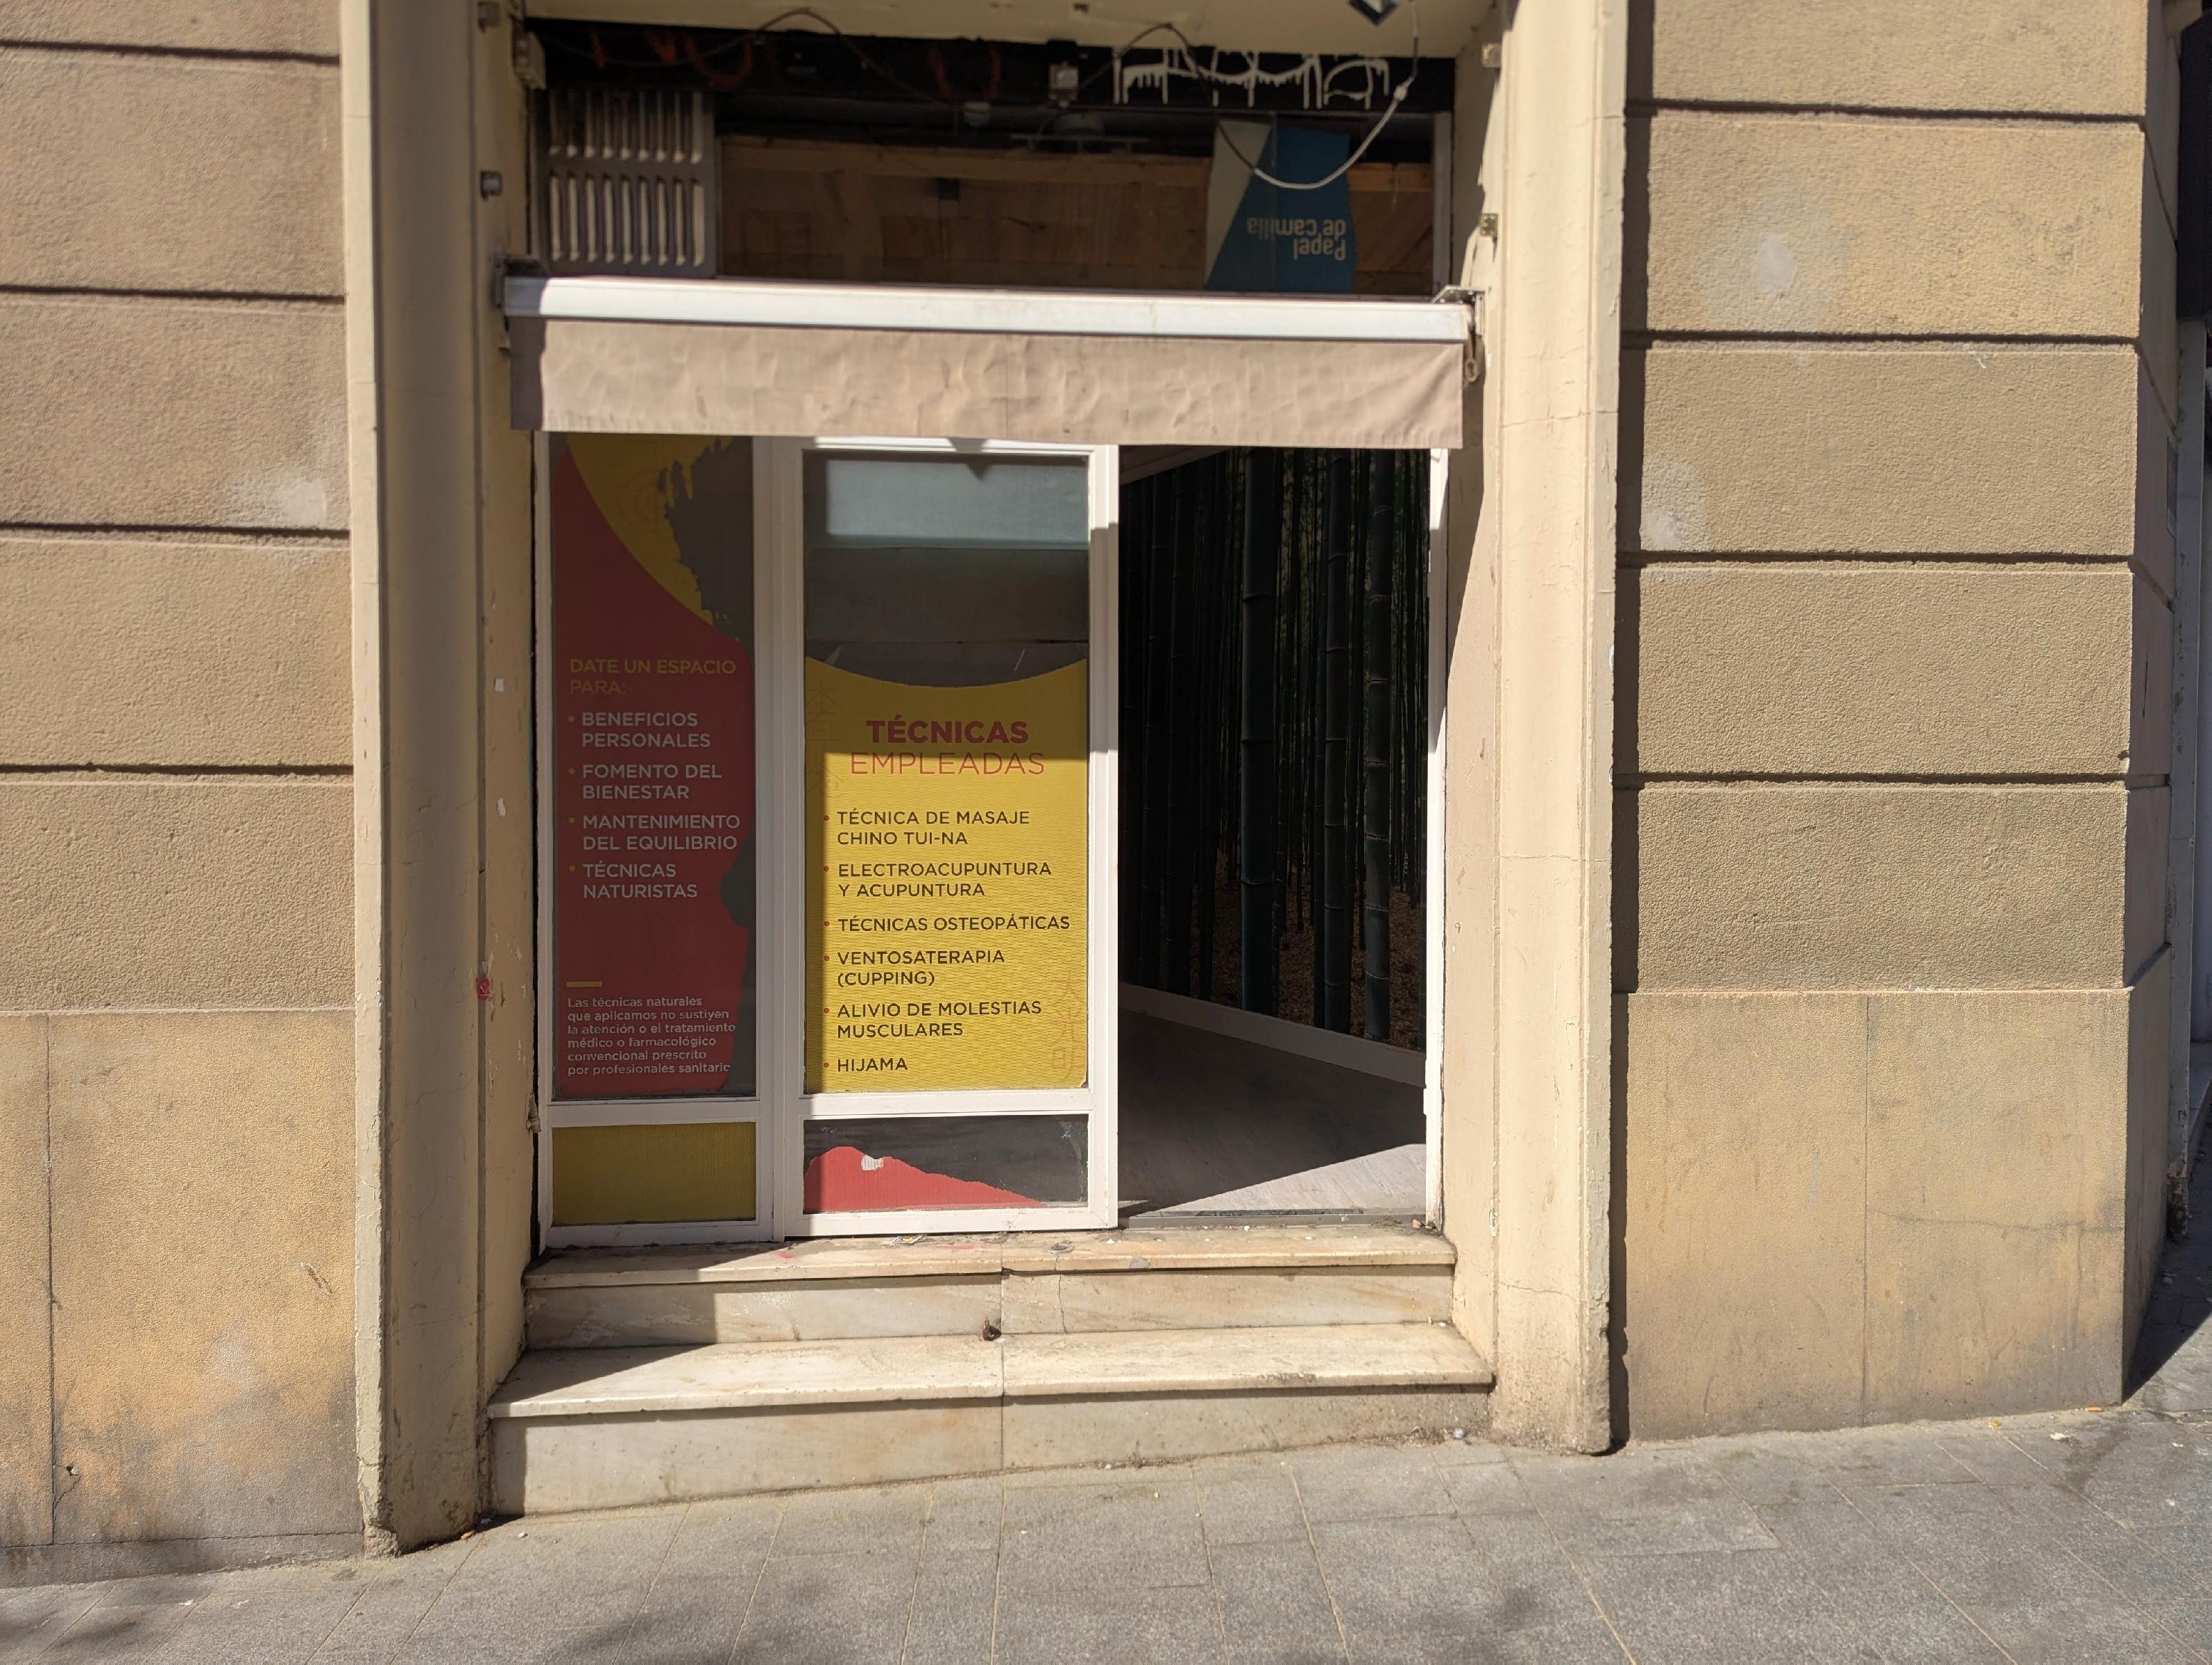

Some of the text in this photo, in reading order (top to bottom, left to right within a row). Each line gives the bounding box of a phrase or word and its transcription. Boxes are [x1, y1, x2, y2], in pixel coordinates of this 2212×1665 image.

[1247, 218, 1346, 241] de camilla
[1294, 237, 1346, 260] Papel
[570, 659, 736, 674] DATE UN ESPACIO
[570, 681, 626, 694] PARA:
[582, 712, 698, 726] BENEFICIOS
[866, 715, 1029, 744] TÉCNICAS
[582, 733, 711, 747] PERSONALES
[851, 753, 1044, 774] EMPLEADAS
[583, 765, 722, 778] FOMENTO DEL
[583, 785, 689, 799] BIENESTAR
[583, 815, 740, 829] MANTENIMIENTO
[837, 808, 1030, 824] TÉCNICA DE MASAJE
[583, 836, 738, 851] DEL EQUILIBRIO
[837, 832, 968, 845] CHINO TUI-NA
[583, 860, 677, 878] TÉCNICAS
[839, 862, 1052, 876] ELECTROACUPUNTURA
[583, 884, 697, 898] NATURISTAS
[838, 883, 985, 896] Y ACUPUNTURA
[838, 914, 1070, 931] TÉCNICAS OSTEOPÁTICAS
[838, 950, 1005, 965] VENTOSATERAPIA
[837, 971, 935, 987] (CUPPING)
[568, 996, 702, 1007] Las técnicas naturales
[568, 1013, 590, 1023] que
[595, 1010, 656, 1021] aplicamos
[680, 1009, 729, 1020] sustiyen
[837, 1001, 1041, 1018] ALIVIO DE MOLESTIAS
[568, 1025, 577, 1034] la
[582, 1024, 634, 1034] atención
[651, 1023, 661, 1033] el
[665, 1023, 735, 1032] tratamiento
[837, 1023, 962, 1038] MUSCULARES
[568, 1038, 613, 1048] médico
[629, 1036, 716, 1048] farmacológico
[568, 1050, 706, 1061] convencional prescrito
[568, 1066, 589, 1077] por
[593, 1064, 674, 1076] profesionales
[838, 1057, 908, 1072] HIJAMA
